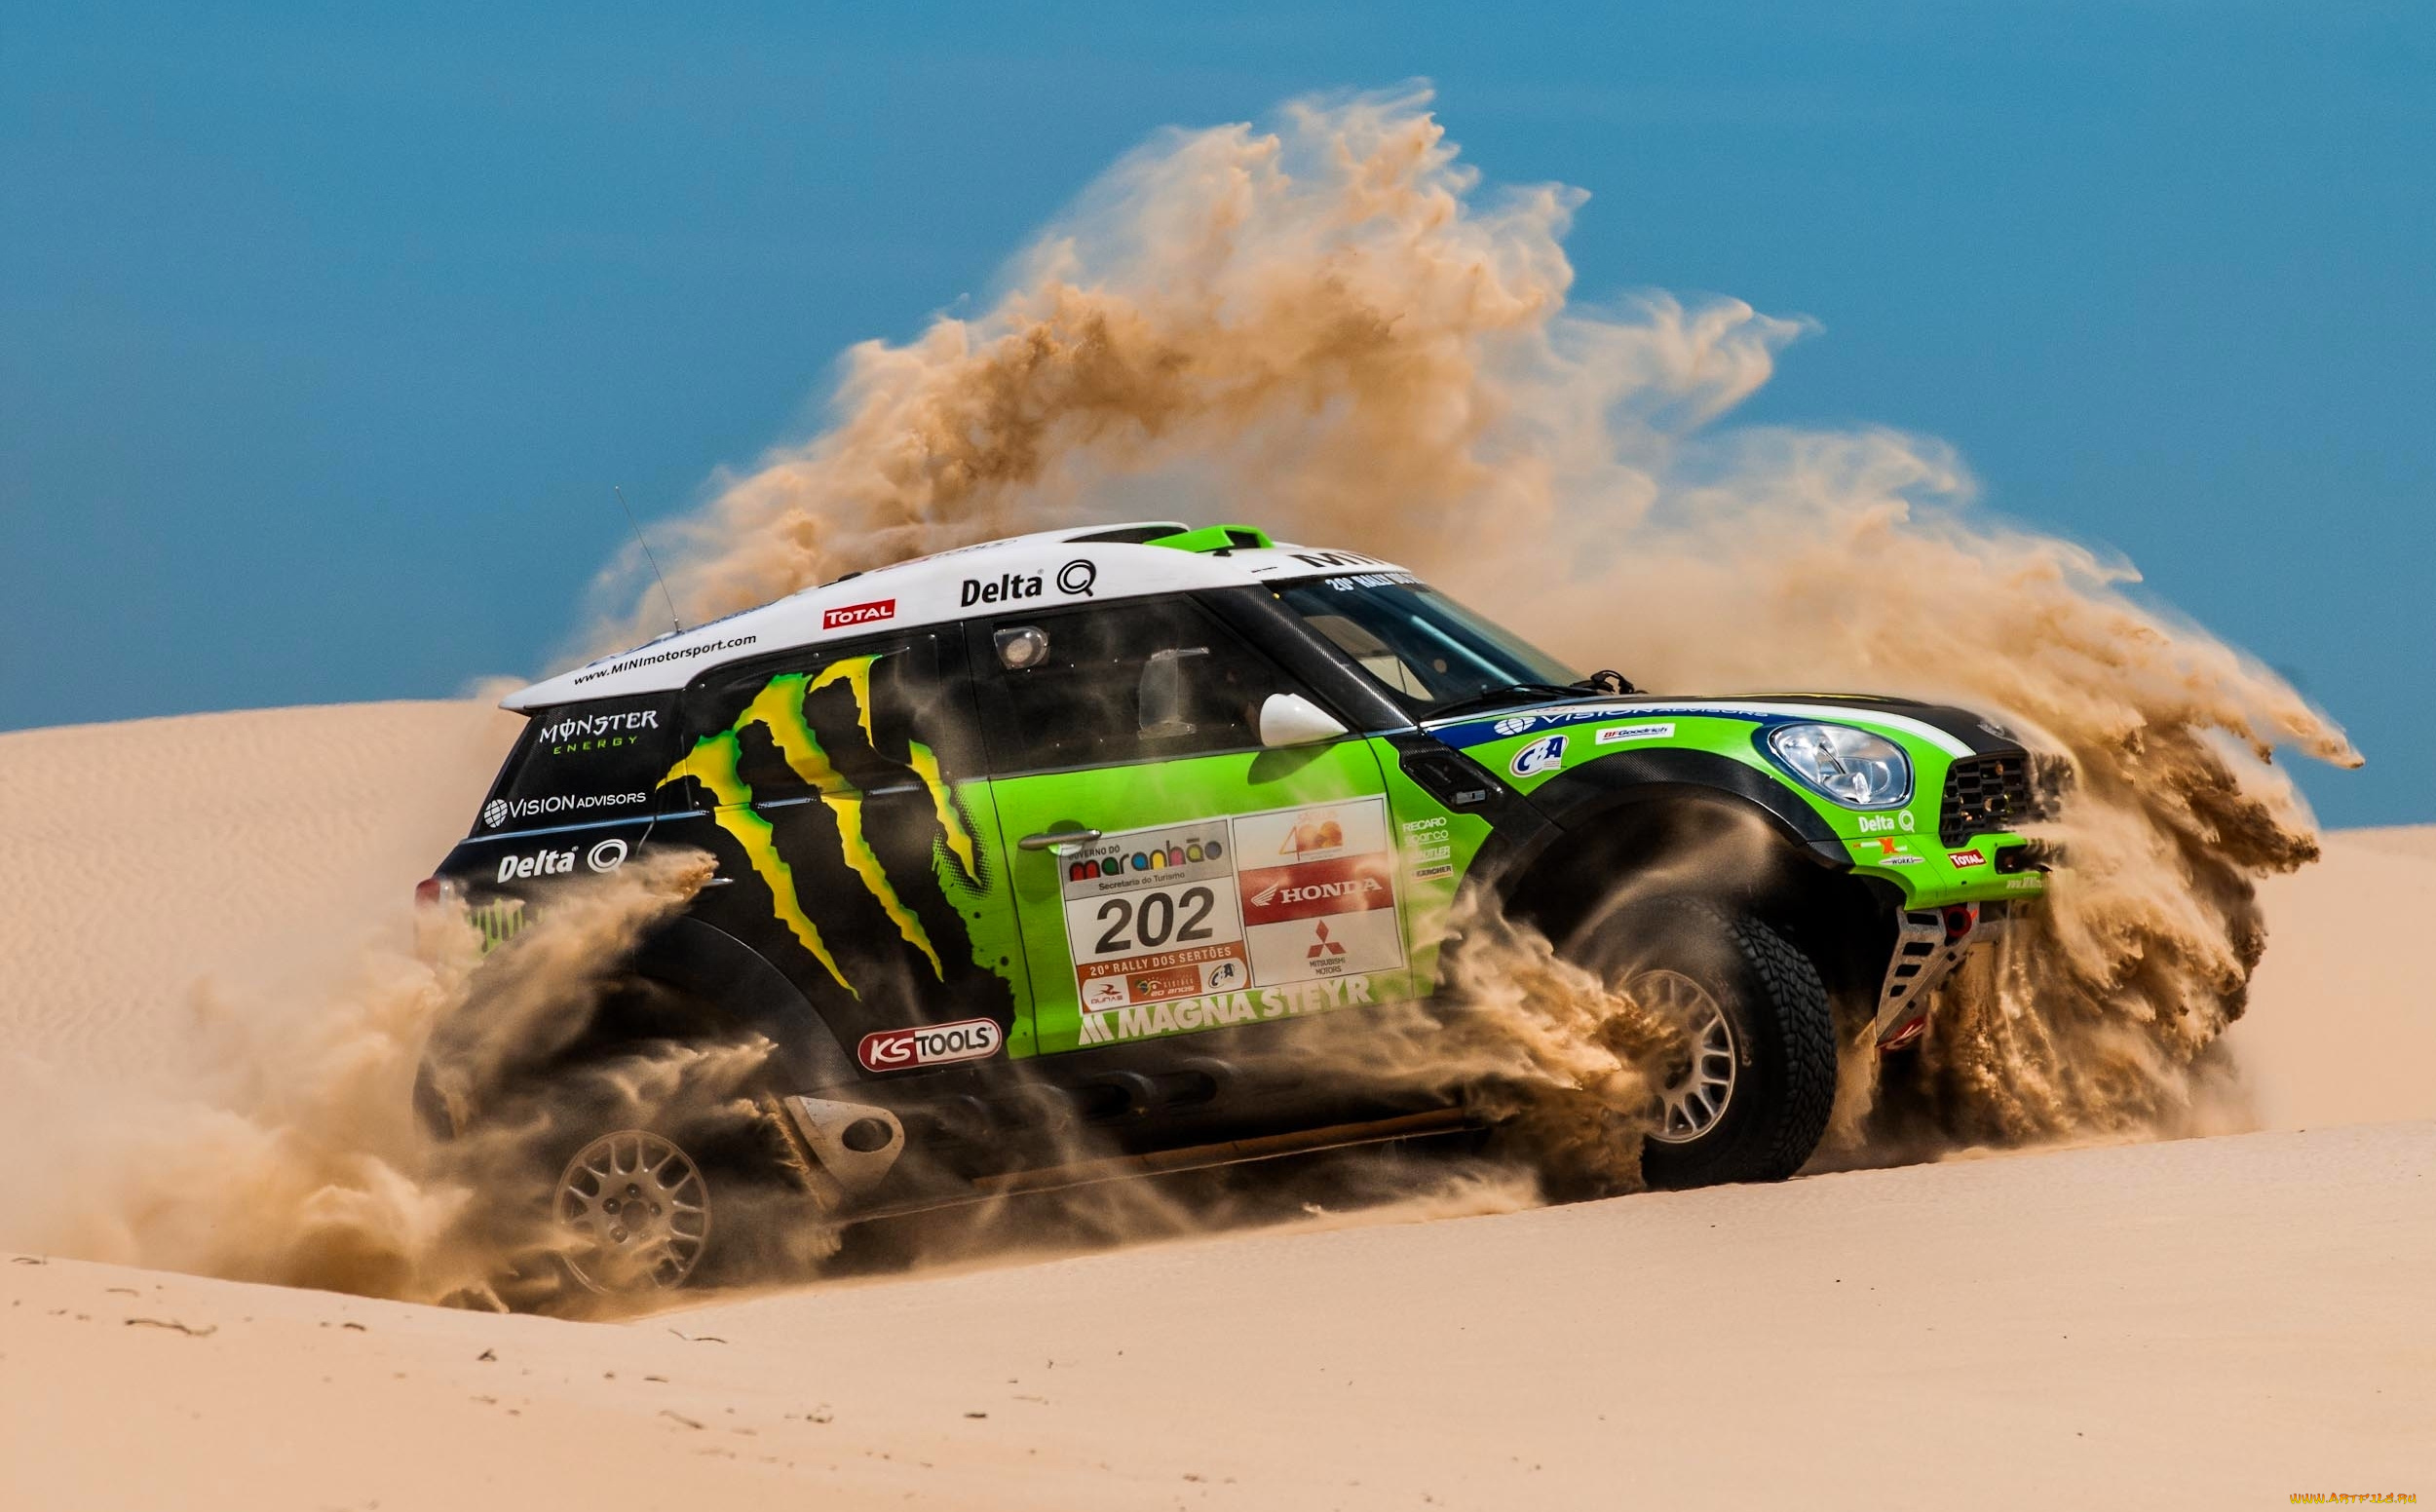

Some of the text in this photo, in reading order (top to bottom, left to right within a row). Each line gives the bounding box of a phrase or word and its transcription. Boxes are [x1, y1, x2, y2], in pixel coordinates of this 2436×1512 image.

[961, 574, 1043, 608] Delta
[574, 635, 757, 685] www.MINImotorsport.com
[539, 710, 660, 743] MONSTER
[1604, 727, 1668, 738] BFGoodrich
[552, 736, 639, 755] ENERGY
[509, 792, 647, 818] VISION ADVISORS
[1403, 816, 1447, 832] RECARO
[1857, 816, 1895, 833] Delta
[497, 849, 577, 884] Delta
[1069, 837, 1223, 882] maranhão
[1098, 878, 1140, 891] Secretaria
[1154, 871, 1186, 883] Turismo
[1280, 878, 1384, 904] HONDA
[1095, 886, 1215, 954] 202
[1113, 959, 1149, 973] RALLY
[1153, 955, 1176, 967] DOS
[1178, 946, 1233, 964] SERTÕES
[1310, 957, 1346, 968] MITSUBISHI
[1315, 965, 1342, 975] MOTORS
[1118, 975, 1373, 1040] MAGNA STEYR
[914, 1026, 991, 1057] TOOLS
